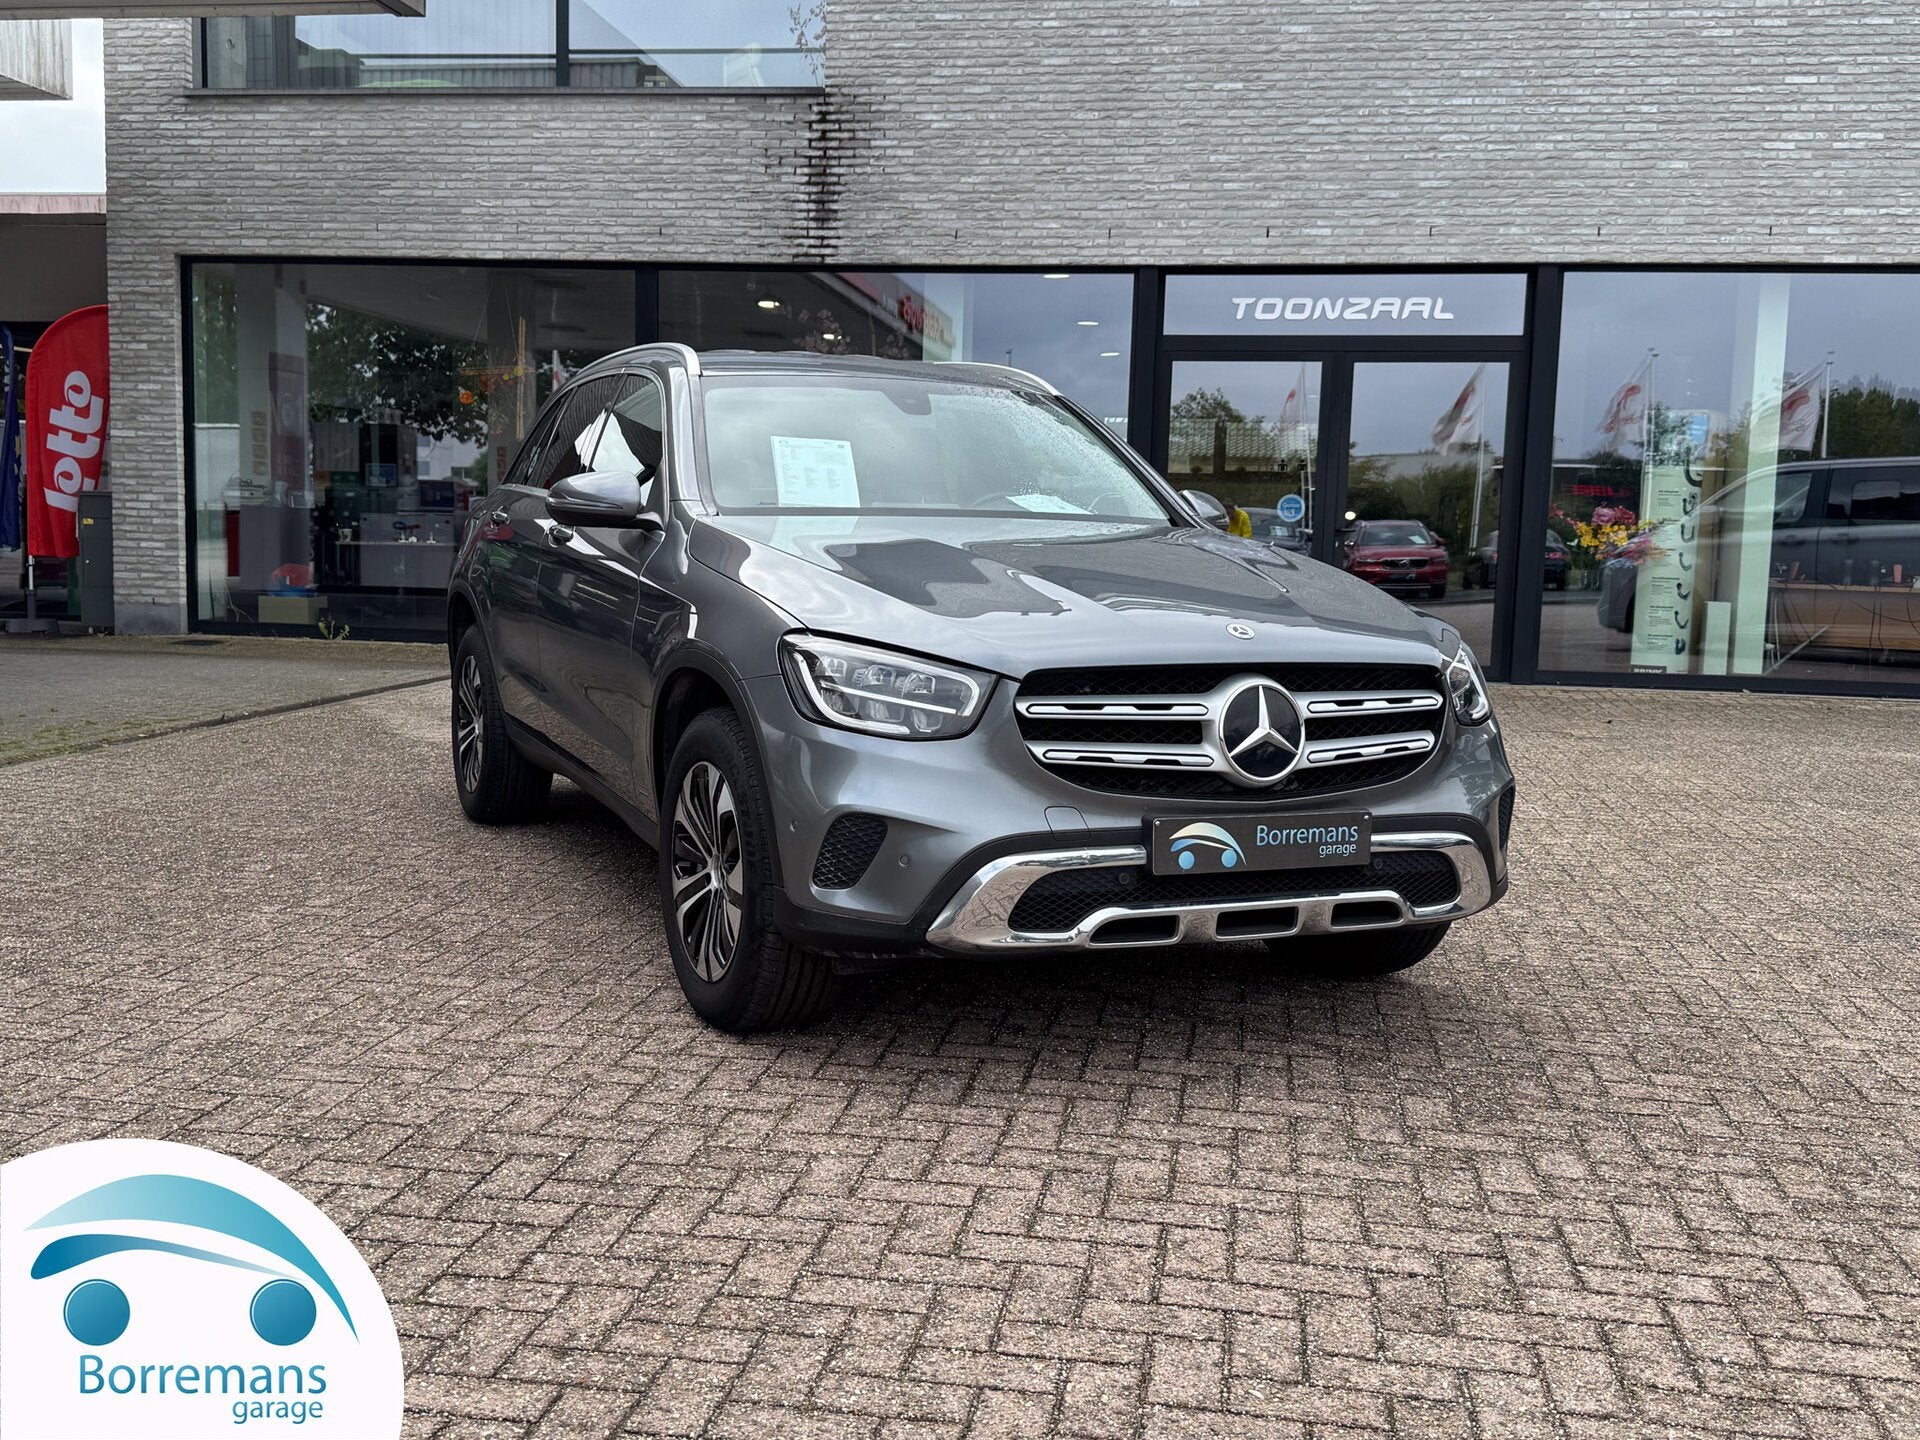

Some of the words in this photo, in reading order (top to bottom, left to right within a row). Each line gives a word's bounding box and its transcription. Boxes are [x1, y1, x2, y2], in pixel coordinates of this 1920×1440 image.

[1231, 297, 1455, 321] TOONZAAL
[43, 370, 104, 513] lotto
[1256, 824, 1359, 847] Borremans
[1319, 843, 1357, 858] garage
